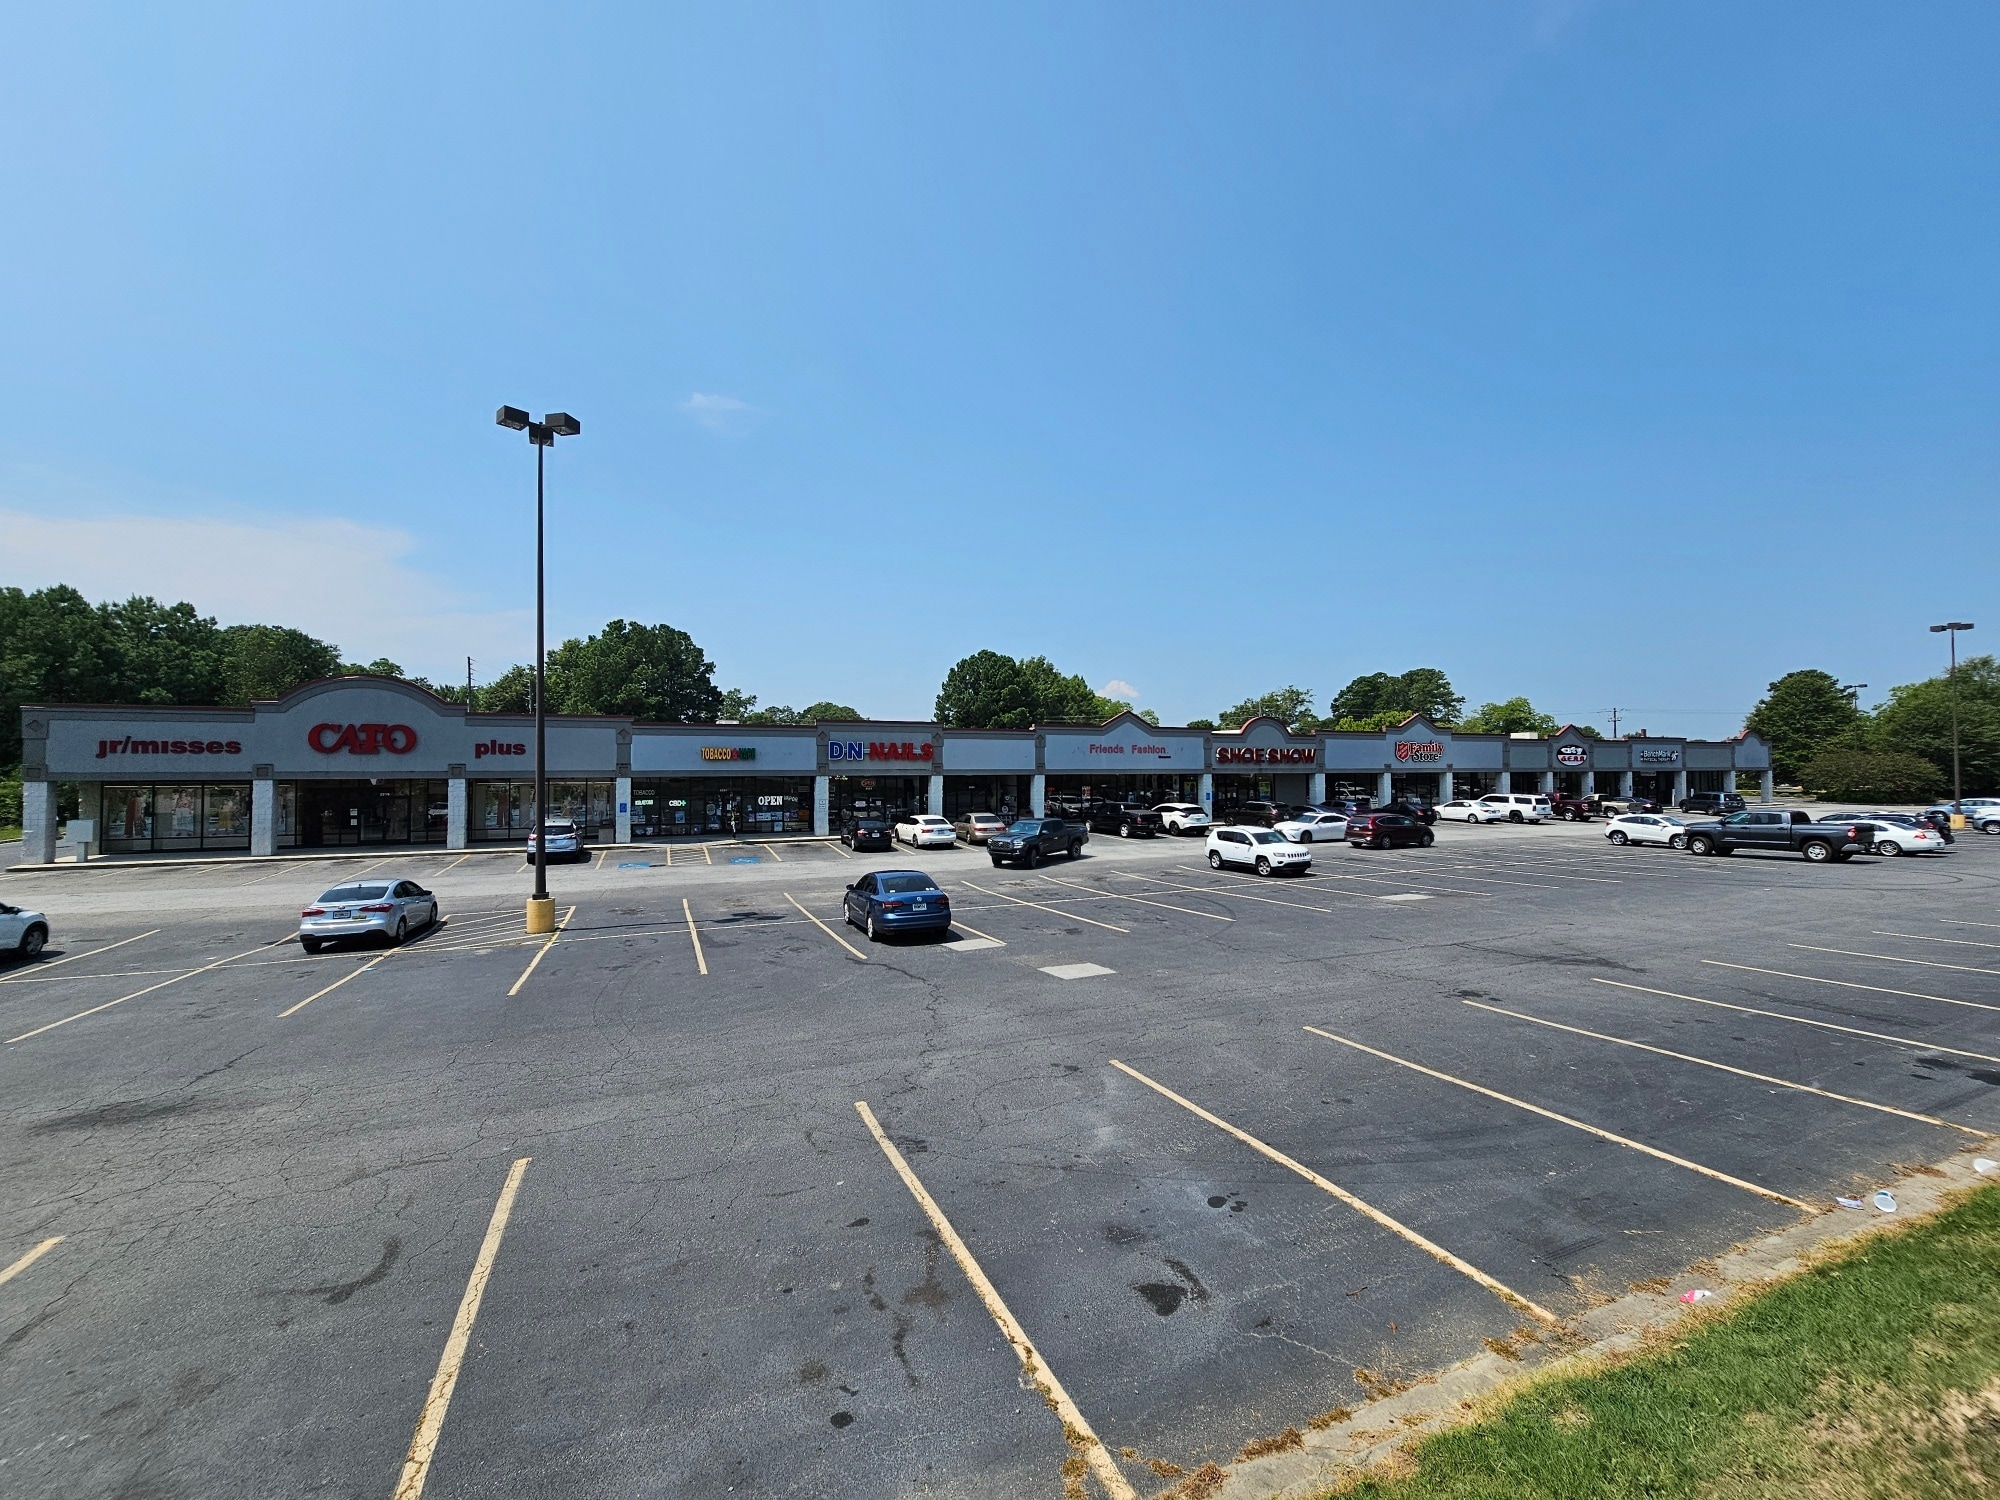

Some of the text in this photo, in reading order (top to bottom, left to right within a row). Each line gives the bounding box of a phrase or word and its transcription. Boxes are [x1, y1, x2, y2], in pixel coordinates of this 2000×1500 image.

[307, 723, 417, 754] CATO
[96, 736, 242, 758] jr/misses
[474, 740, 527, 758] plus
[701, 748, 731, 760] TOBACCO
[828, 741, 934, 761] DN NAILS
[1089, 744, 1166, 754] Friends Fashion
[1409, 741, 1444, 756] Family
[1216, 747, 1317, 764] SHOE SHOW
[1413, 751, 1440, 762] Store
[757, 795, 783, 806] OPEN
